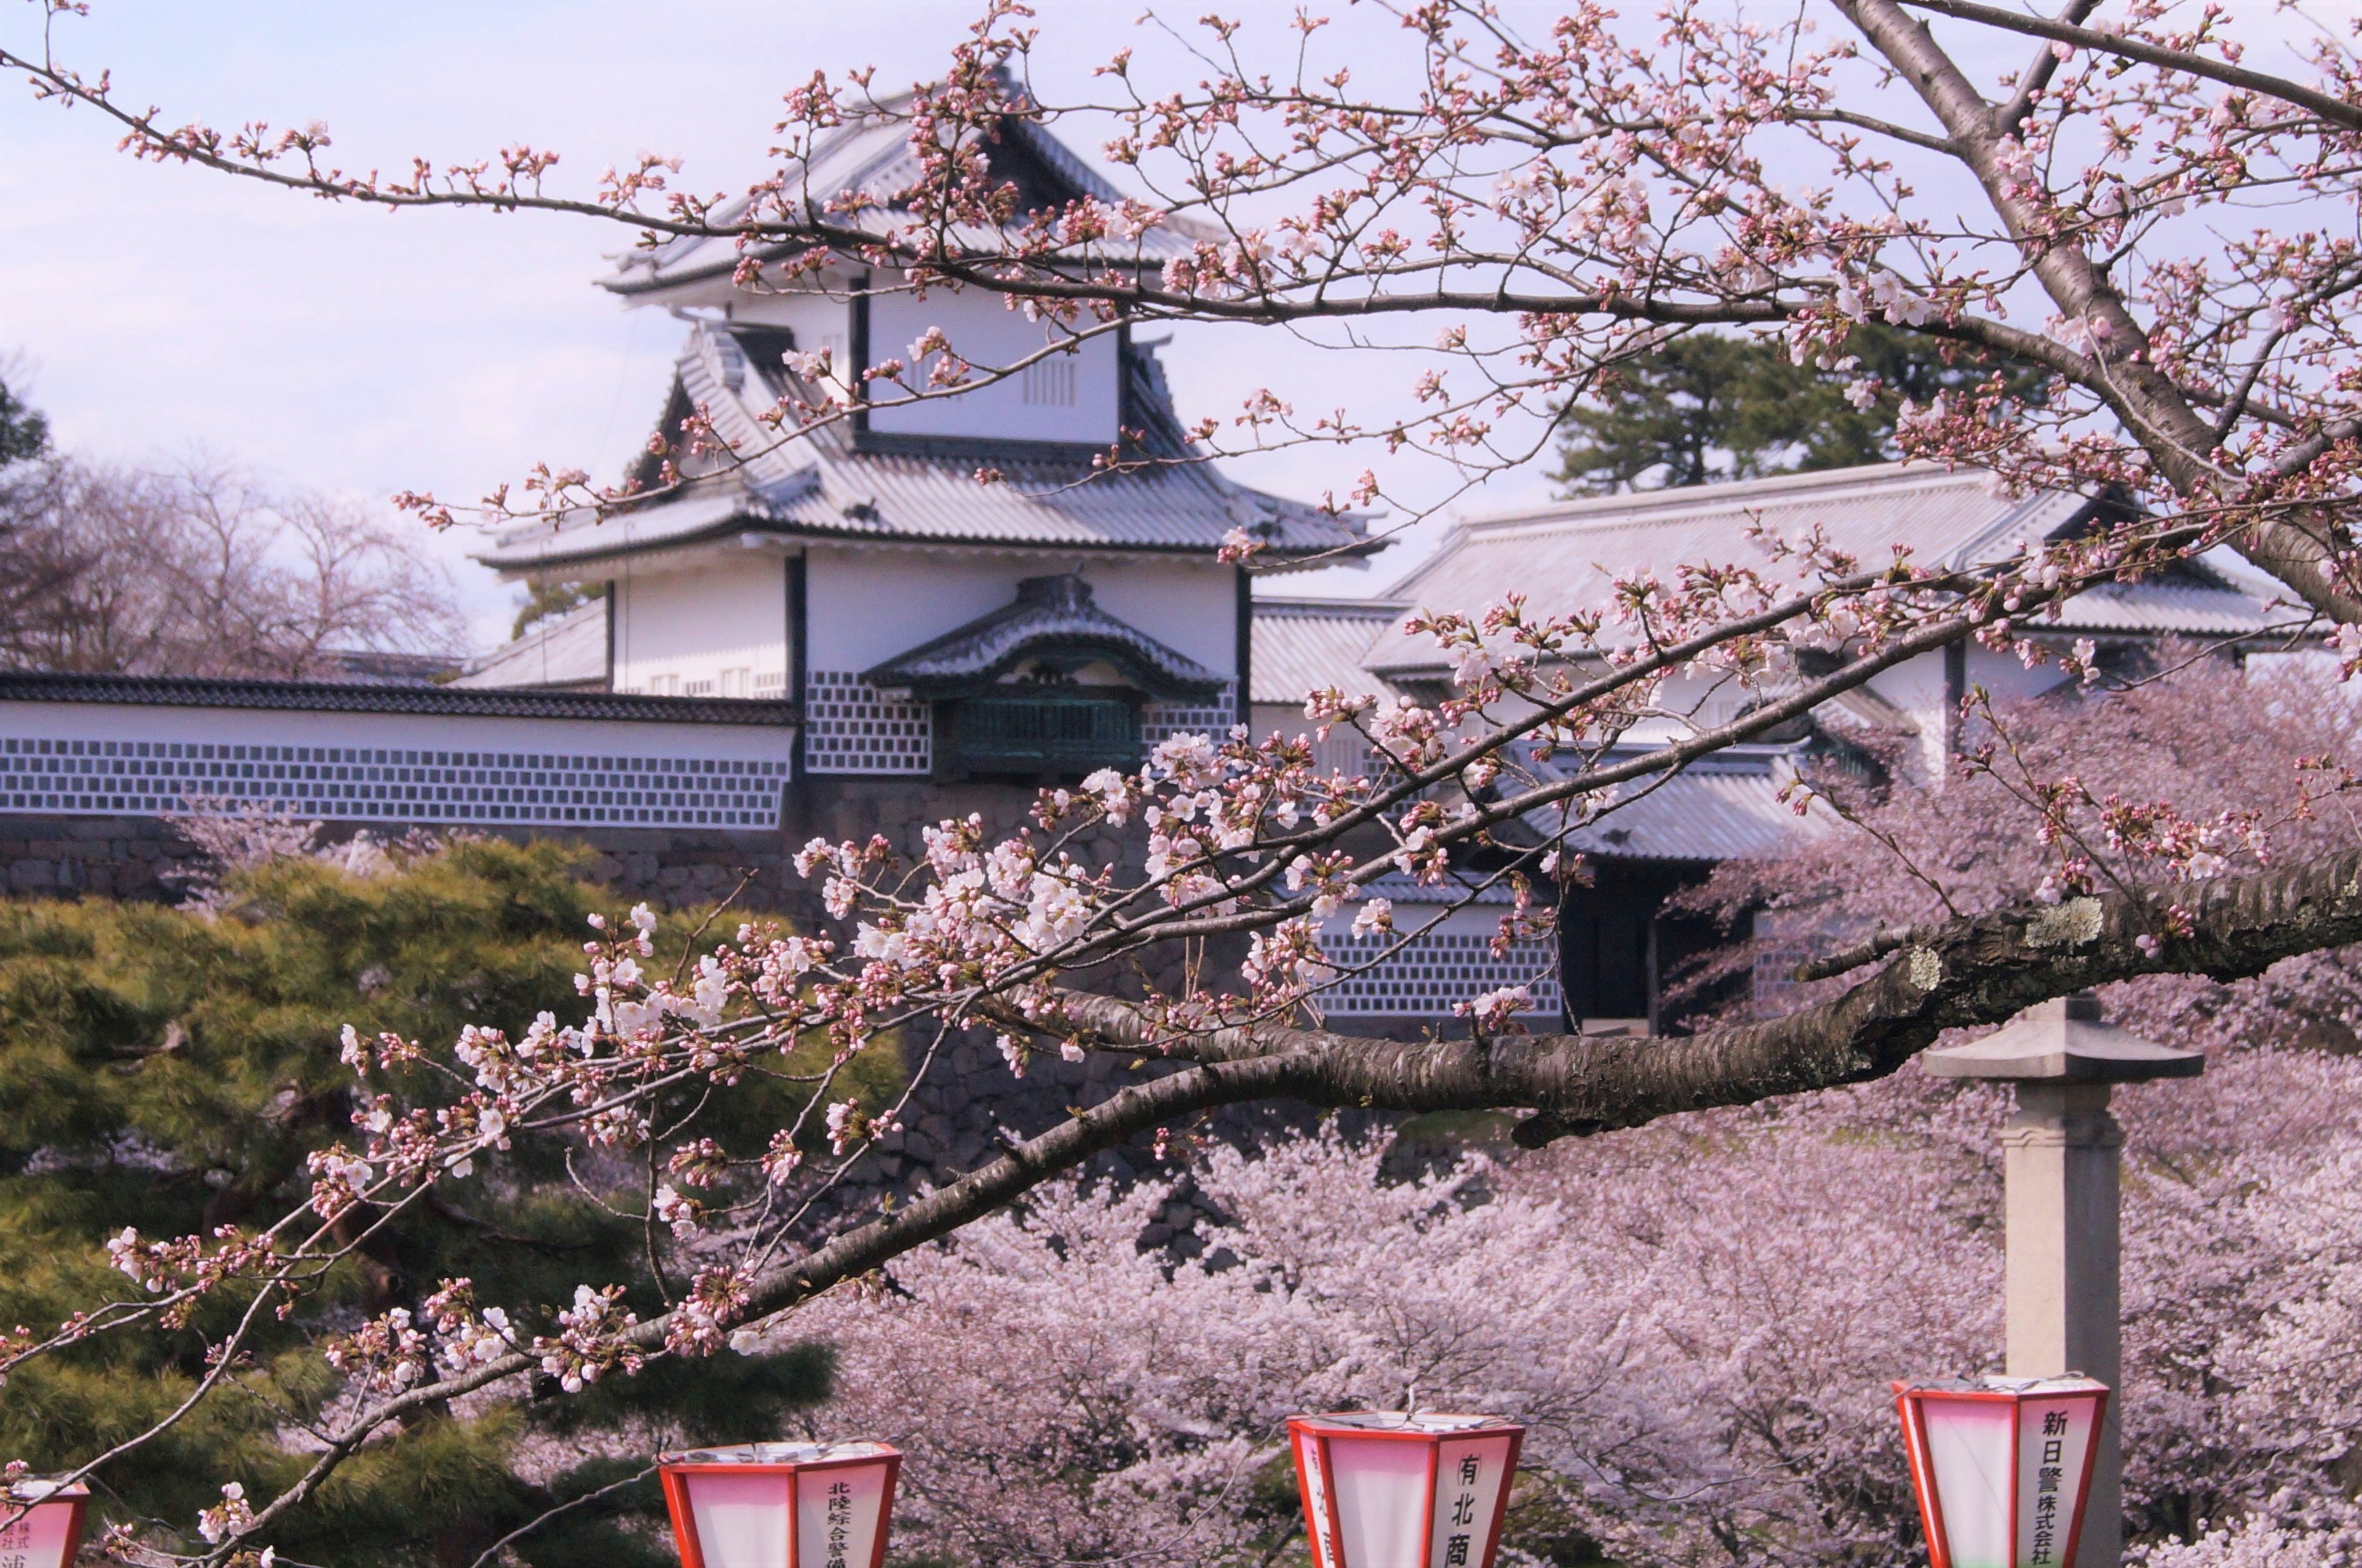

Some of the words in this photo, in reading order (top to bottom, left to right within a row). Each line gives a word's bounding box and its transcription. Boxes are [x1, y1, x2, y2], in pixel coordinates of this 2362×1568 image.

[2030, 1410, 2069, 1566] 新日警株式会社
